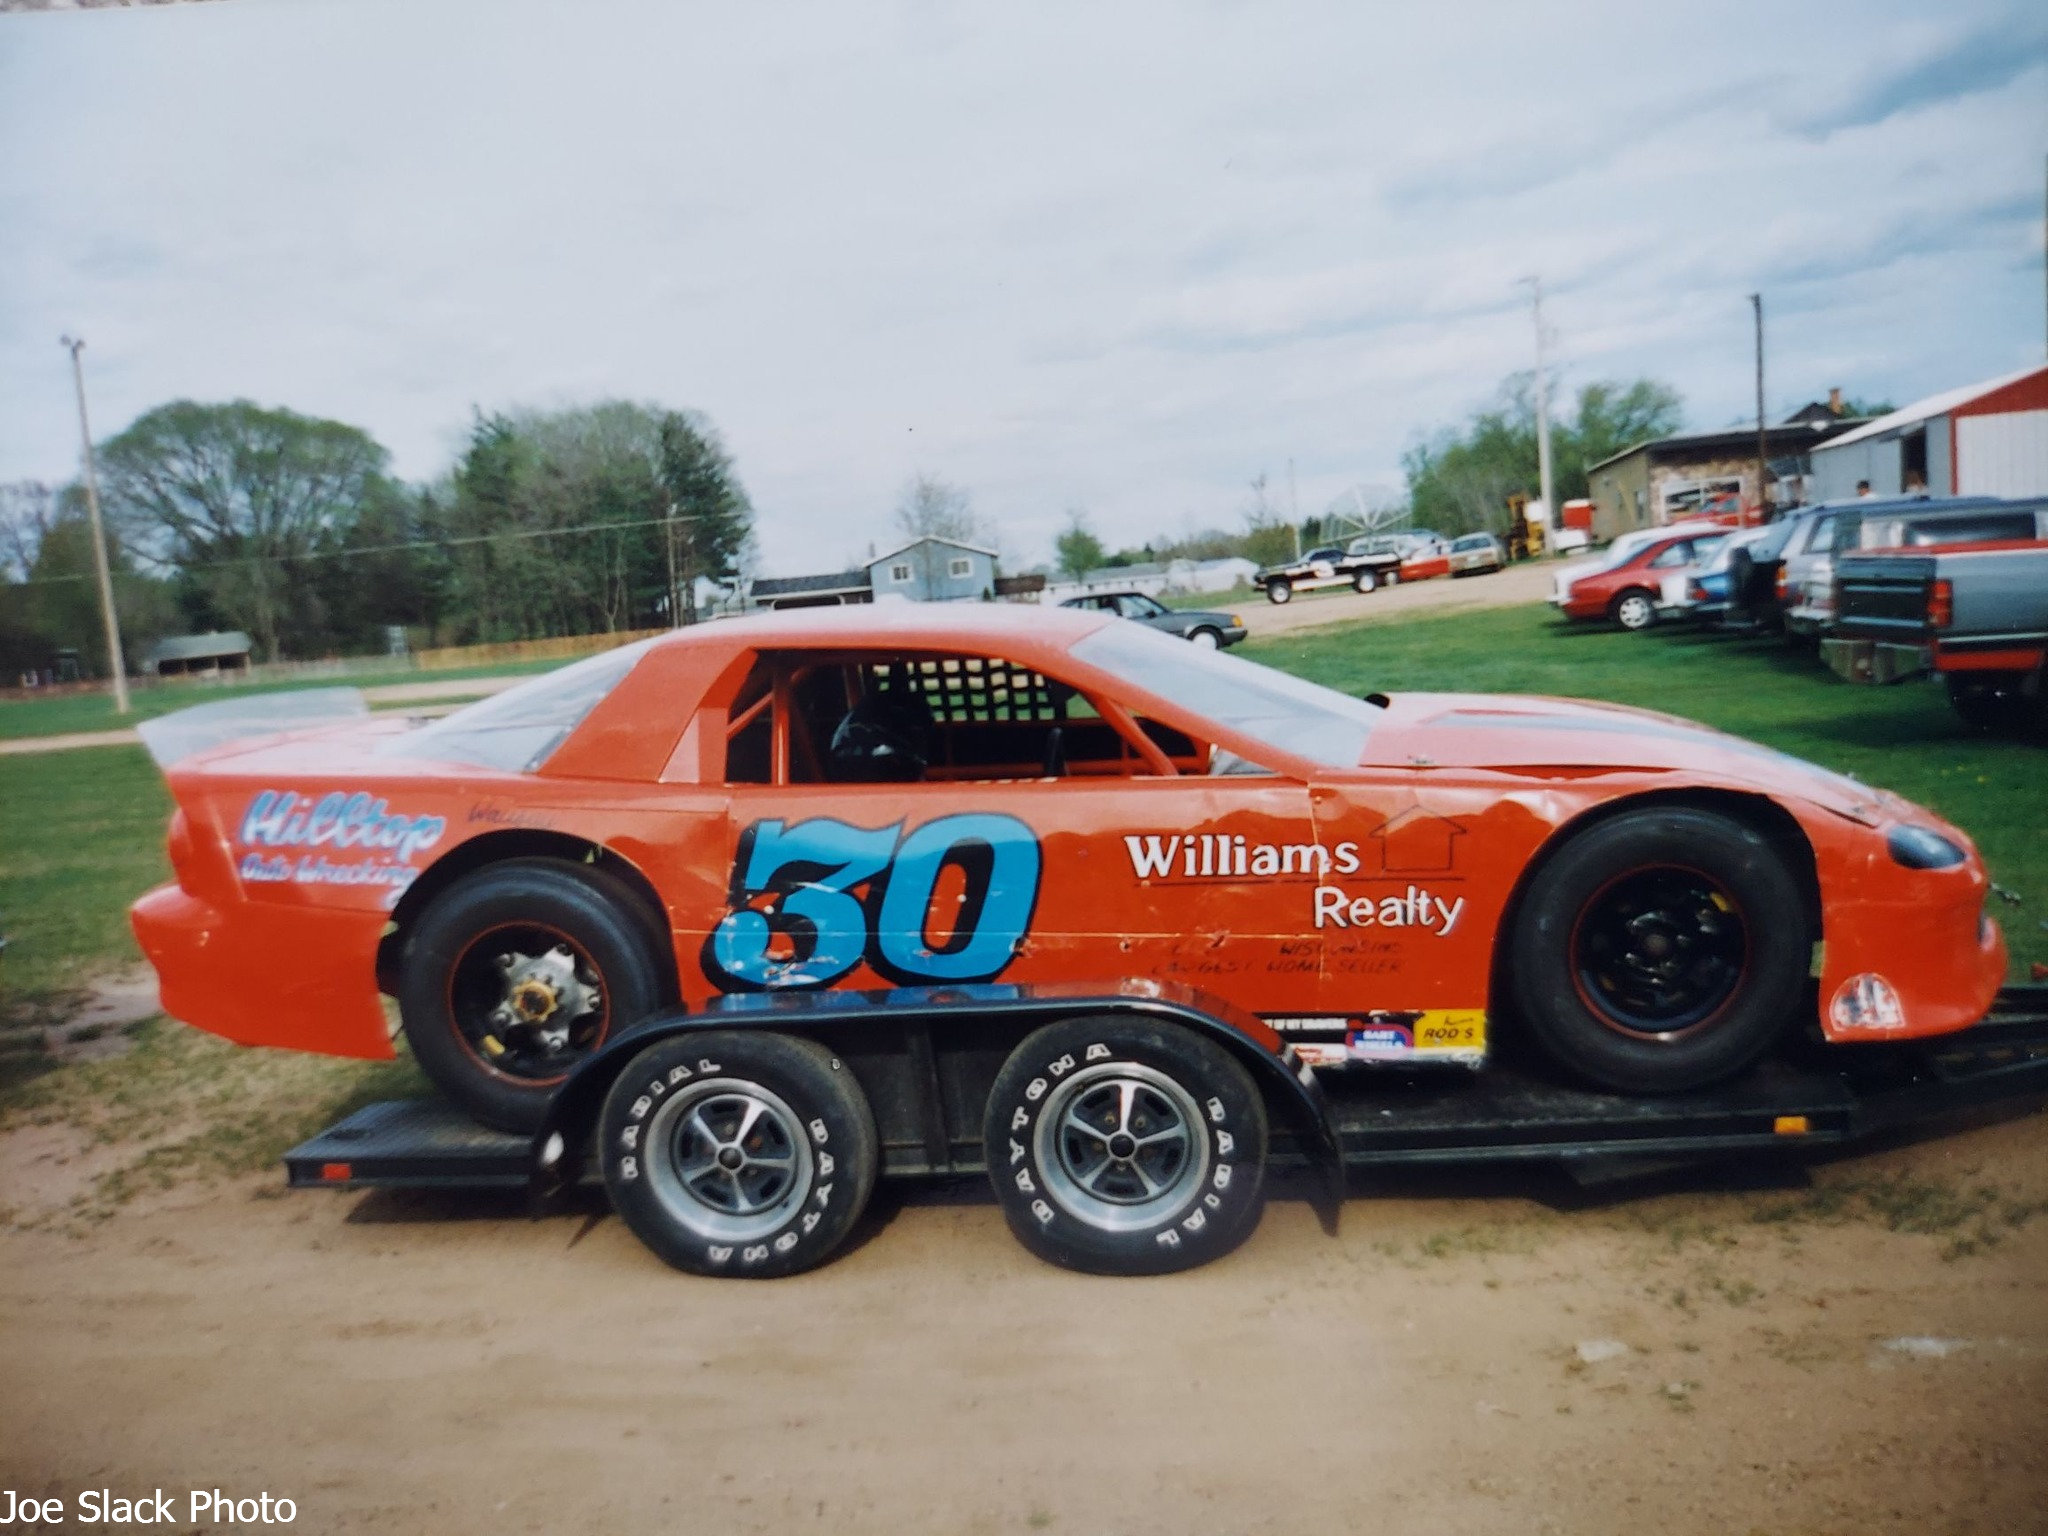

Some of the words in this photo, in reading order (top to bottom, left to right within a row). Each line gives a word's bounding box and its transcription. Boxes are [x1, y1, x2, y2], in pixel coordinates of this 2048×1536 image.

[240, 790, 446, 863] Hilltop
[1123, 834, 1361, 880] Williams
[700, 811, 1042, 995] 30
[1313, 884, 1465, 938] Realty
[619, 1058, 722, 1181] RADIAL
[1009, 1042, 1112, 1225] DAYTONA
[1155, 1096, 1235, 1247] RADIAL
[708, 1117, 835, 1263] DAYTONA
